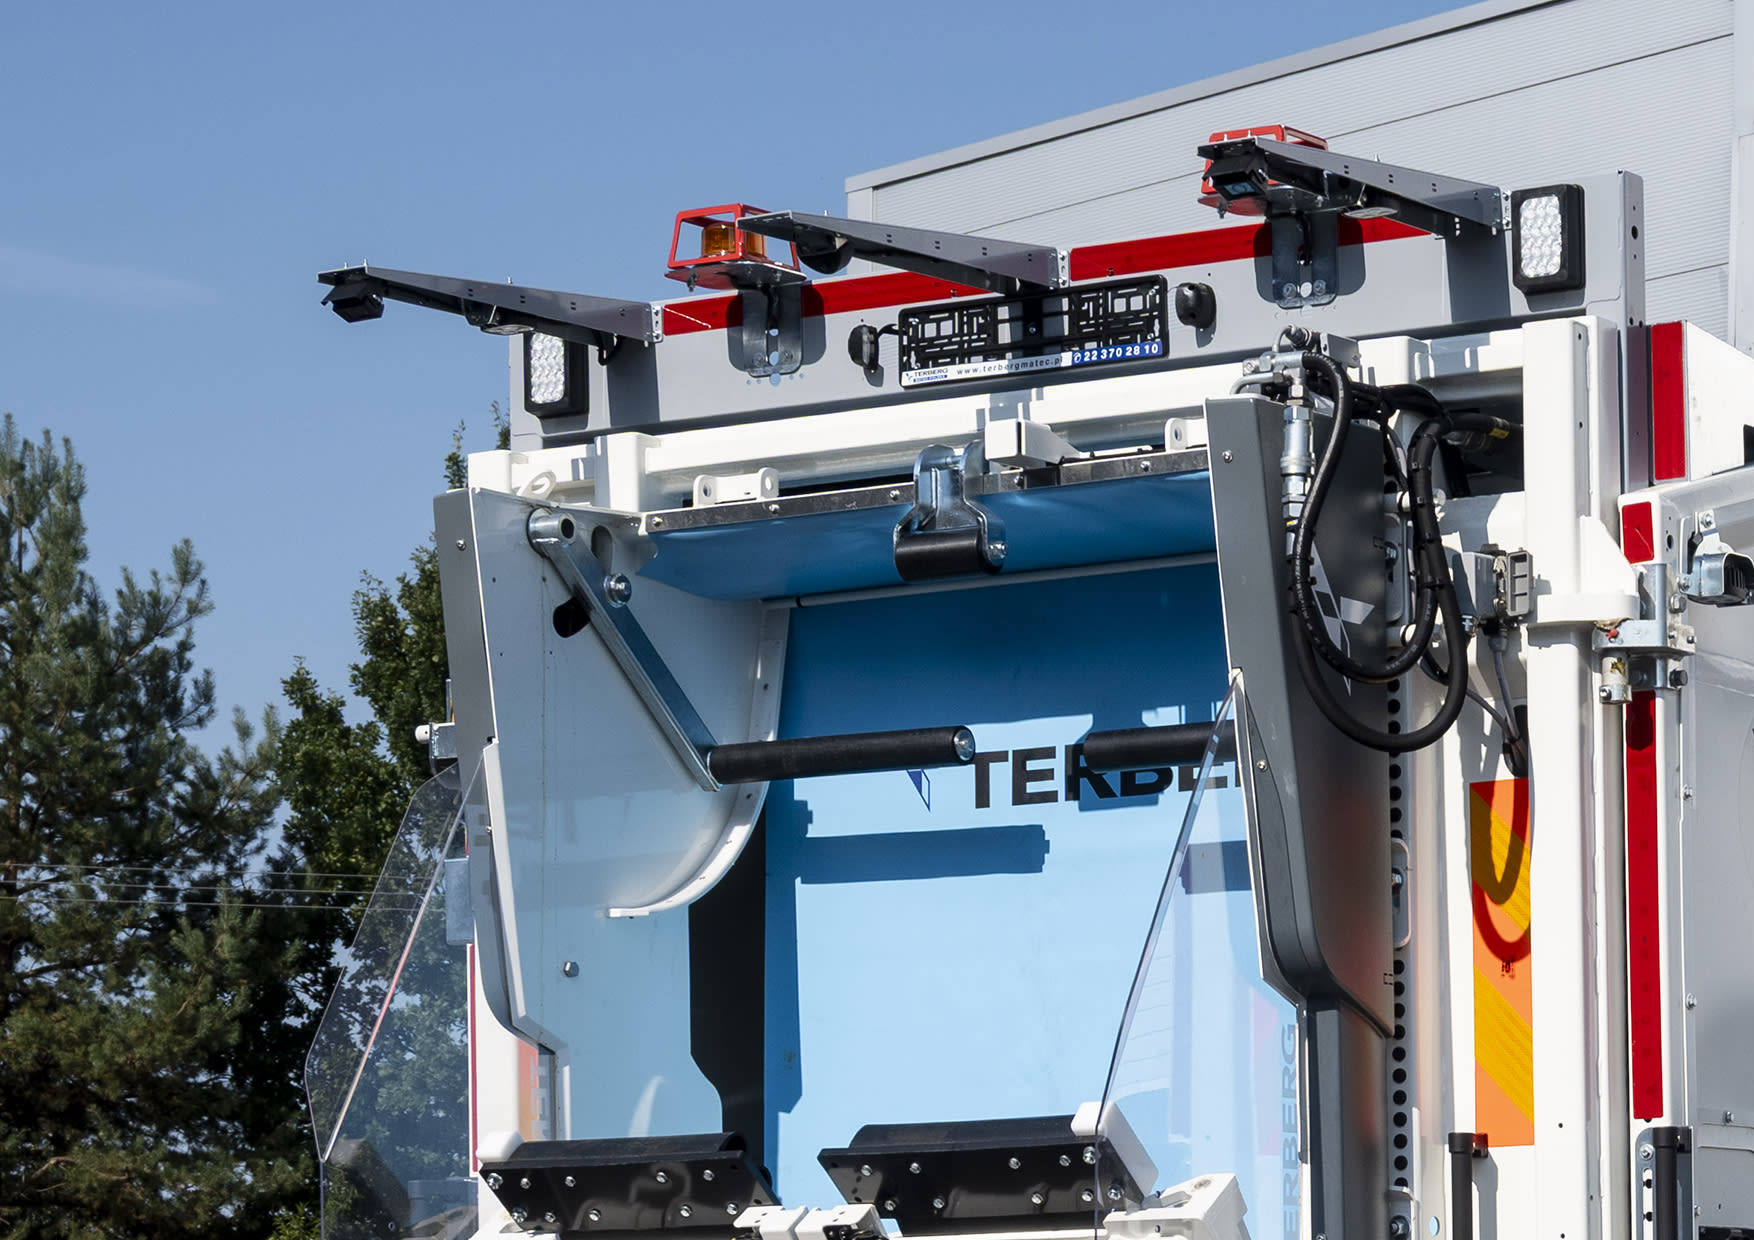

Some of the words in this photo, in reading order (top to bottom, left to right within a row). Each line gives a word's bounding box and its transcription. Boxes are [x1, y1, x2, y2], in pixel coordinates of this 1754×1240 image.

[1083, 351, 1098, 363] 22
[1100, 348, 1123, 361] 370
[1125, 345, 1141, 357] 28
[1144, 343, 1159, 355] 10
[914, 367, 949, 377] TERBERG
